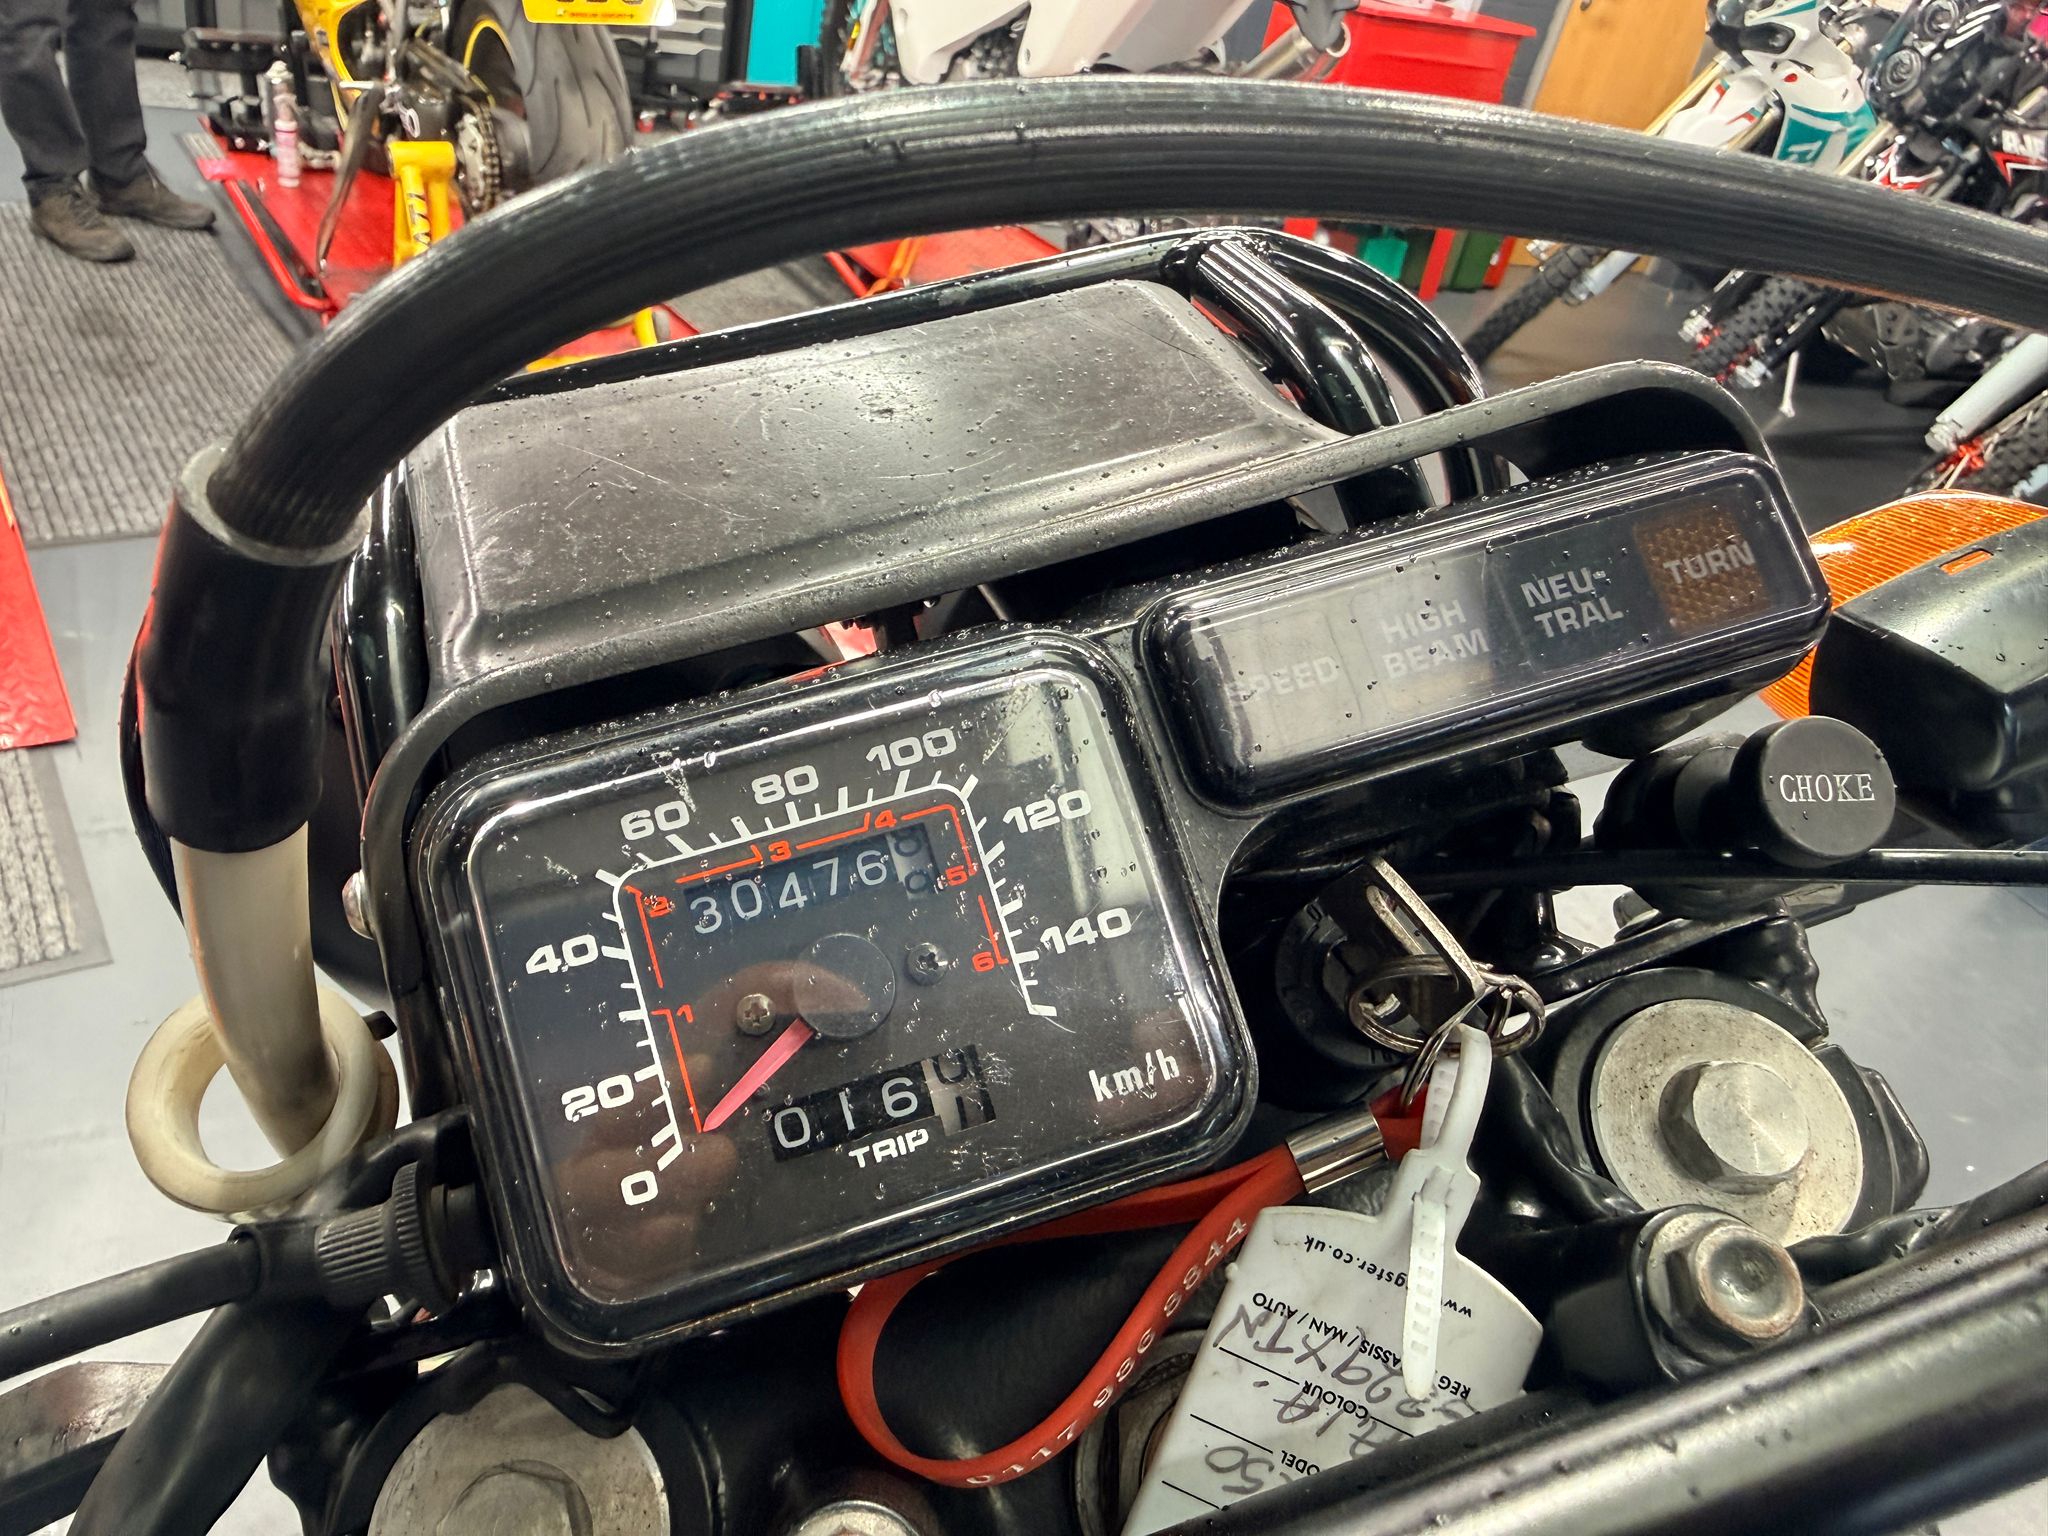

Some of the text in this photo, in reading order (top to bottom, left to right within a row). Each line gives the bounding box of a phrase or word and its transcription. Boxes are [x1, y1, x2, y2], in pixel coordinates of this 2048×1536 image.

[1663, 541, 1756, 586] TURN
[1520, 567, 1607, 608] NEU-
[1381, 602, 1467, 645] HIGH
[1533, 596, 1624, 640] TRAL
[1382, 628, 1490, 680] BEAM
[1228, 655, 1341, 704] SPEED
[866, 727, 957, 772] 100
[751, 765, 819, 805] 80
[1779, 773, 1876, 803] CHOKE
[620, 800, 691, 841] 60
[875, 810, 898, 829] 4
[1002, 789, 1092, 833] 120
[768, 840, 793, 863] 3
[944, 865, 969, 887] 5
[1040, 907, 1132, 954] 140
[525, 934, 599, 975] 40
[972, 952, 995, 972] 6
[1088, 1048, 1181, 1103] km/h
[561, 1074, 635, 1122] 20
[848, 1128, 929, 1169] TRIP
[620, 1169, 659, 1206] 0
[1251, 1291, 1299, 1321] AUTO
[1308, 1317, 1349, 1344] MAN
[1358, 1340, 1404, 1368] ASSIS
[1302, 1379, 1370, 1420] COLOUR
[1437, 1374, 1472, 1400] REG
[966, 1419, 1079, 1484] 0117
[1280, 1449, 1321, 1476] ODEL
